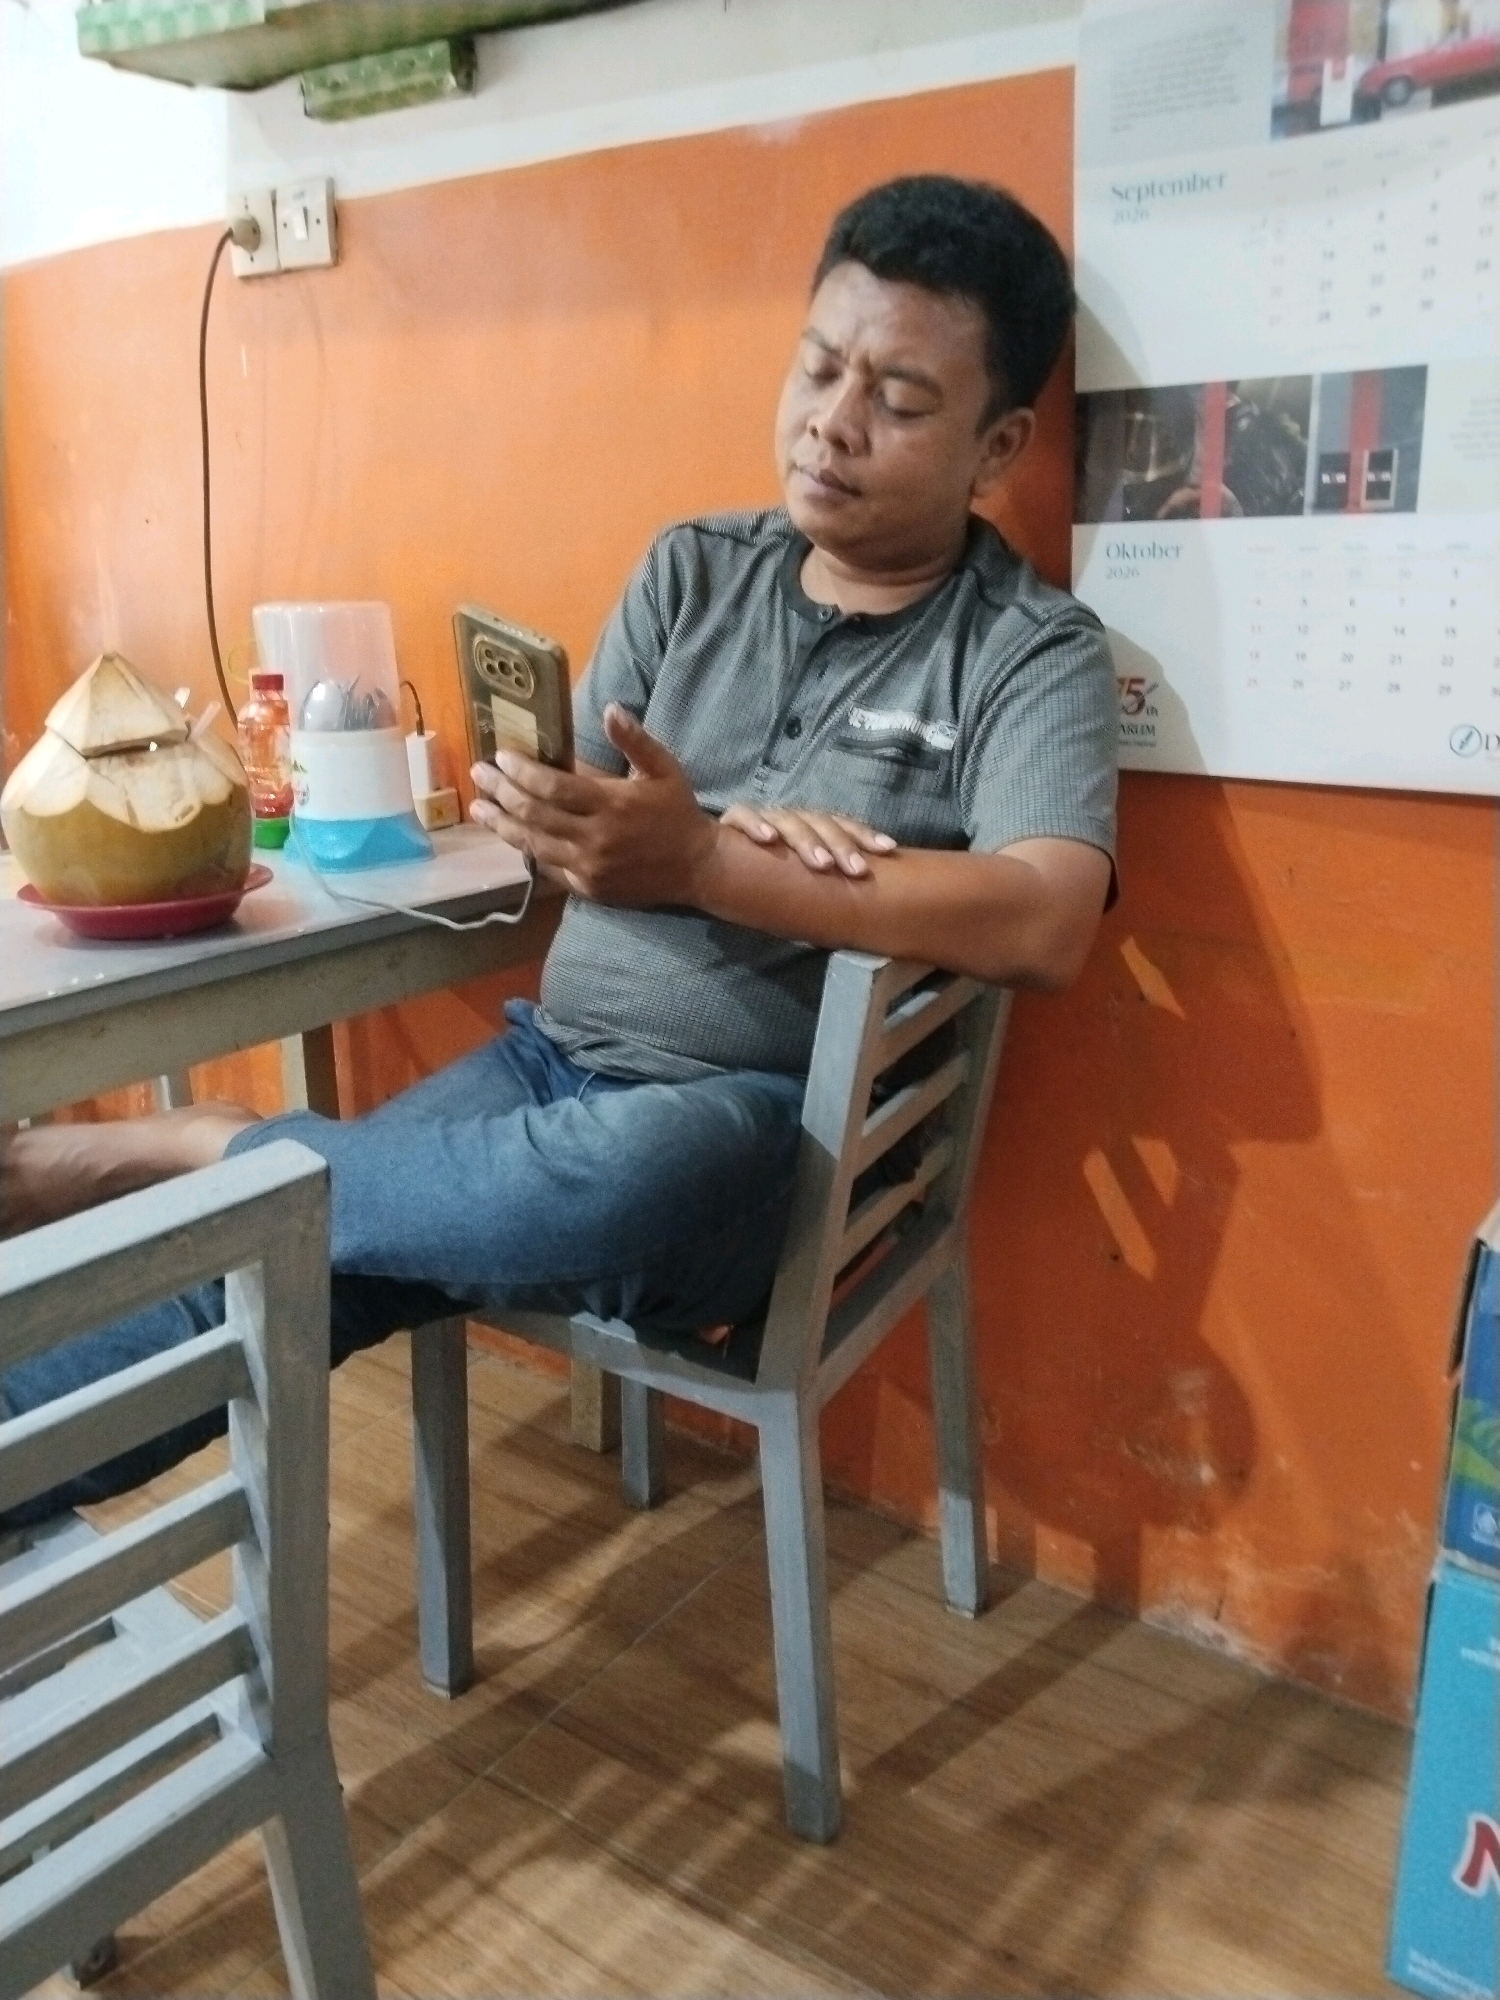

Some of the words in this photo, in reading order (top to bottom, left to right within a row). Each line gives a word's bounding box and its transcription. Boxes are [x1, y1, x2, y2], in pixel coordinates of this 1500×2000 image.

[1111, 172, 1227, 204] September
[1111, 206, 1149, 225] 2026
[1105, 541, 1183, 560] Oktober
[1105, 566, 1140, 580] 2026
[1297, 624, 1309, 635] 12
[1344, 624, 1357, 636] 13
[1393, 625, 1406, 636] 14
[1444, 626, 1457, 638] 15
[1295, 651, 1307, 662] 19
[1341, 652, 1354, 664] 20
[1389, 653, 1402, 665] 21
[1441, 655, 1454, 667] 22
[1292, 678, 1304, 690] 26
[1338, 679, 1352, 691] 27
[1387, 681, 1401, 694] 28
[1437, 683, 1452, 696] 29
